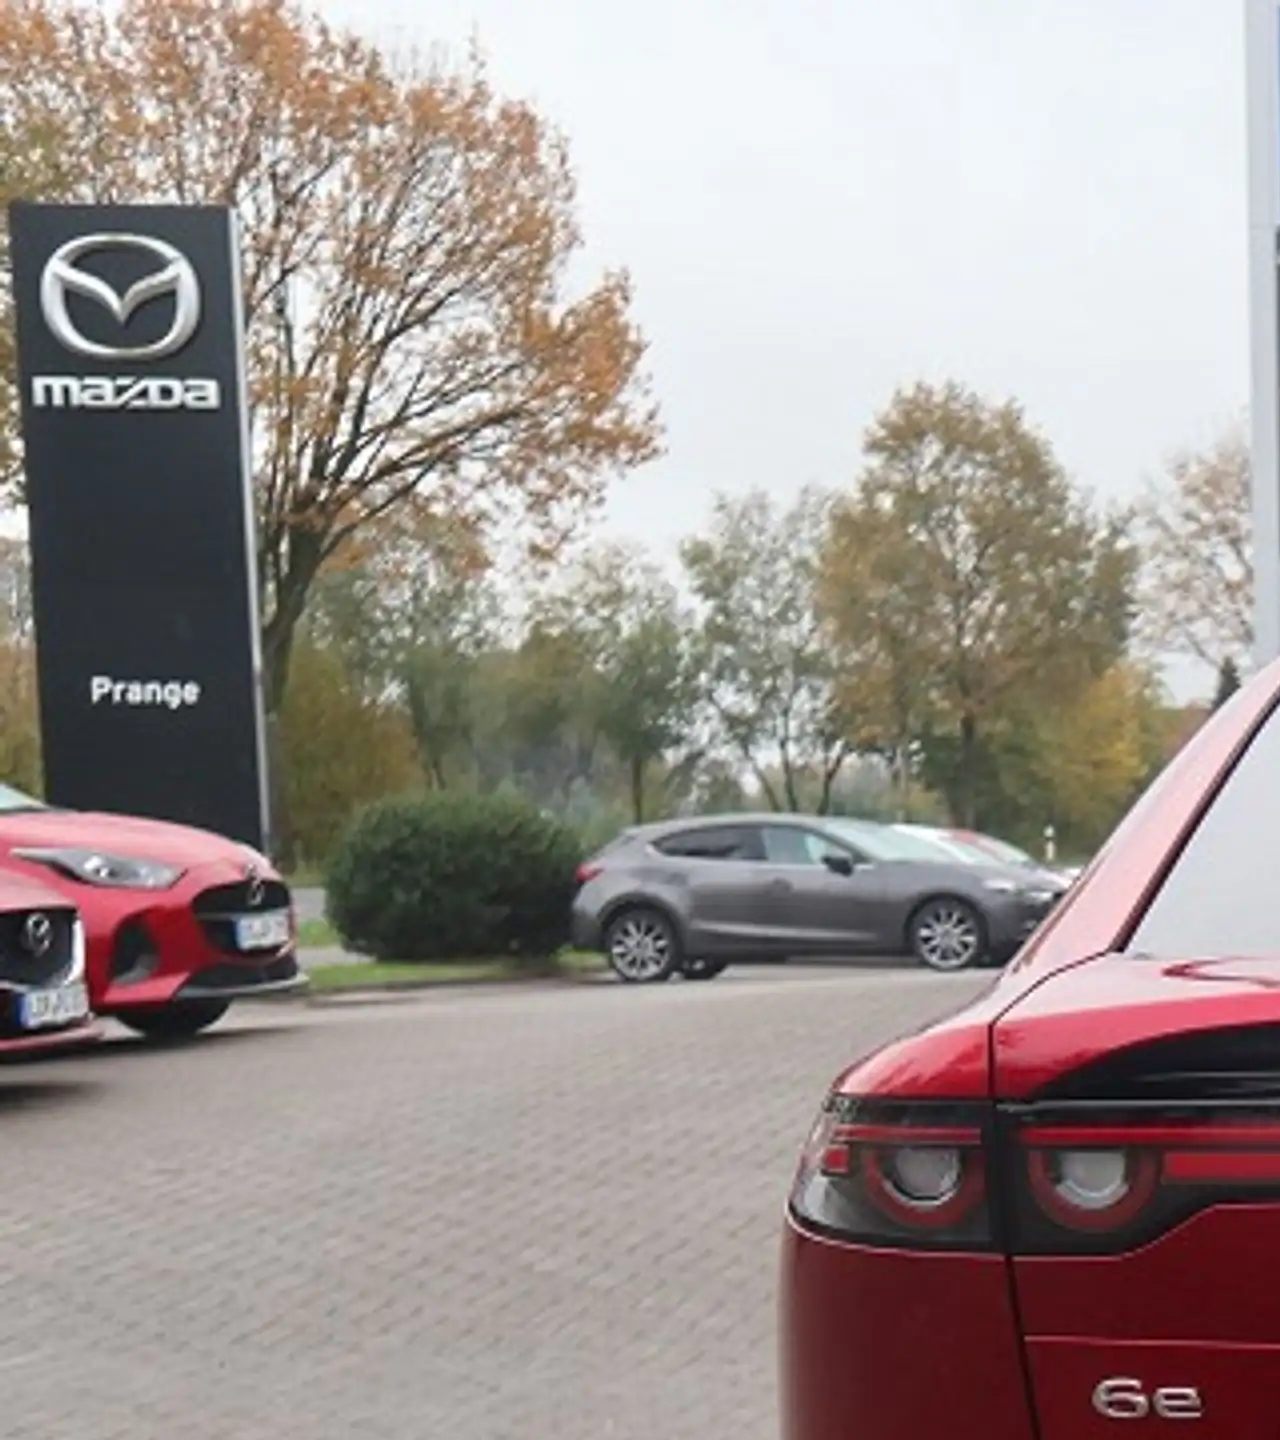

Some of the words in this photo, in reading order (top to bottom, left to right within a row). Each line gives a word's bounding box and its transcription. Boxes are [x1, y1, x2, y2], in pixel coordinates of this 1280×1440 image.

[32, 375, 220, 409] mazda
[91, 675, 201, 710] Prange
[1092, 1376, 1202, 1418] 6e
